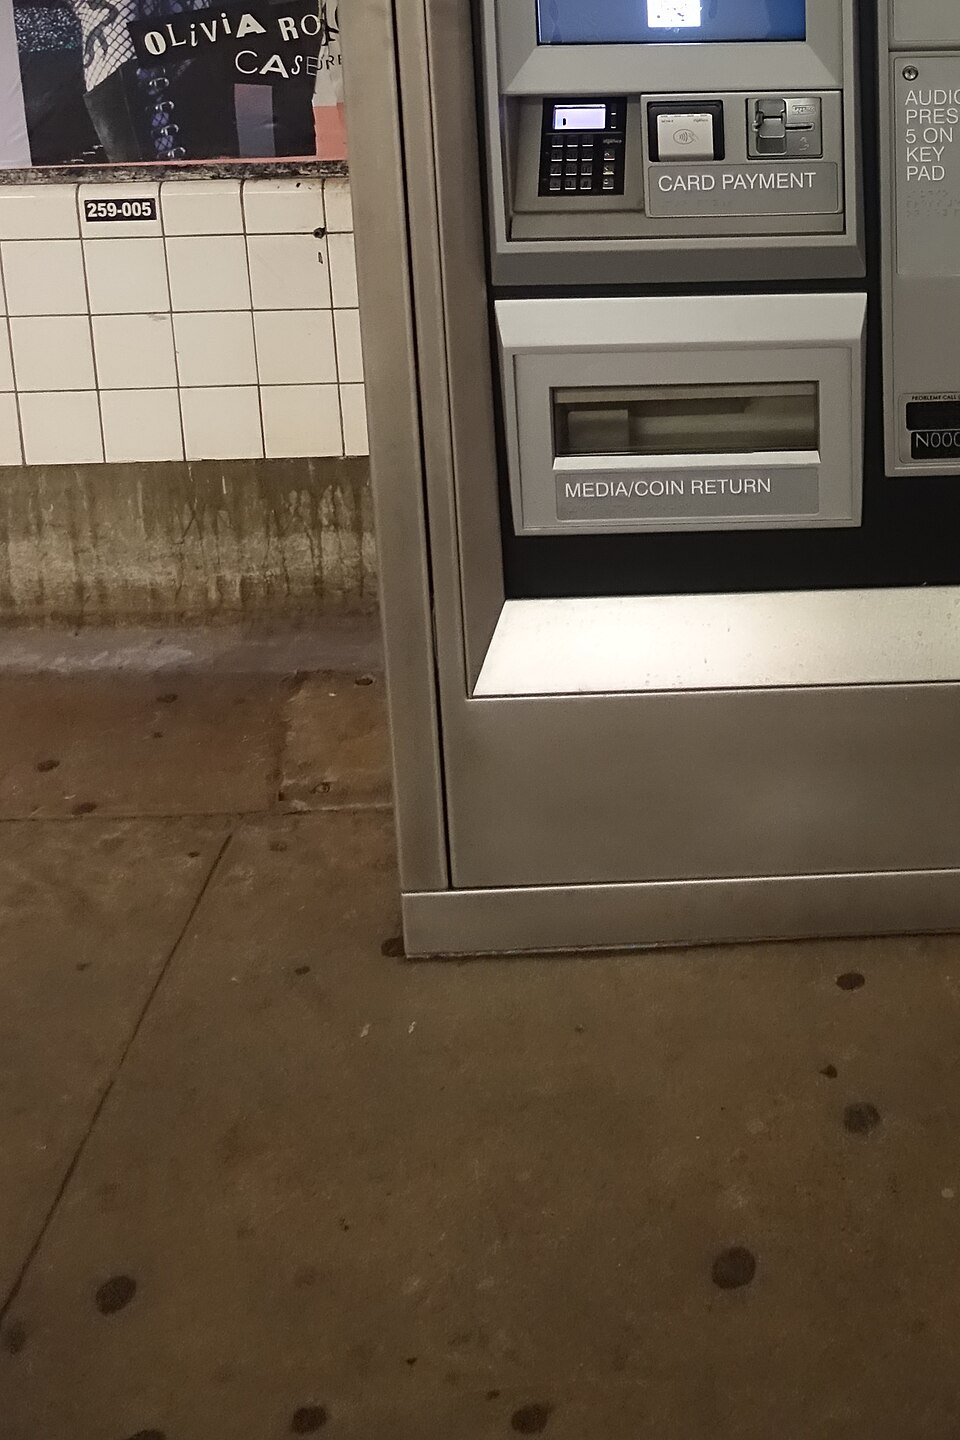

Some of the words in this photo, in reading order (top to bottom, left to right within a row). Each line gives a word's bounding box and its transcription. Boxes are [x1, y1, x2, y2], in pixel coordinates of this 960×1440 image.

[906, 128, 916, 144] 5
[923, 128, 954, 144] ON
[906, 146, 944, 162] KEY
[658, 174, 716, 192] CARD
[722, 171, 816, 190] PAYMENT
[906, 165, 946, 181] PAD
[87, 201, 152, 219] 259-005
[564, 479, 684, 499] MEDIA/COIN
[690, 477, 772, 496] RETURN
